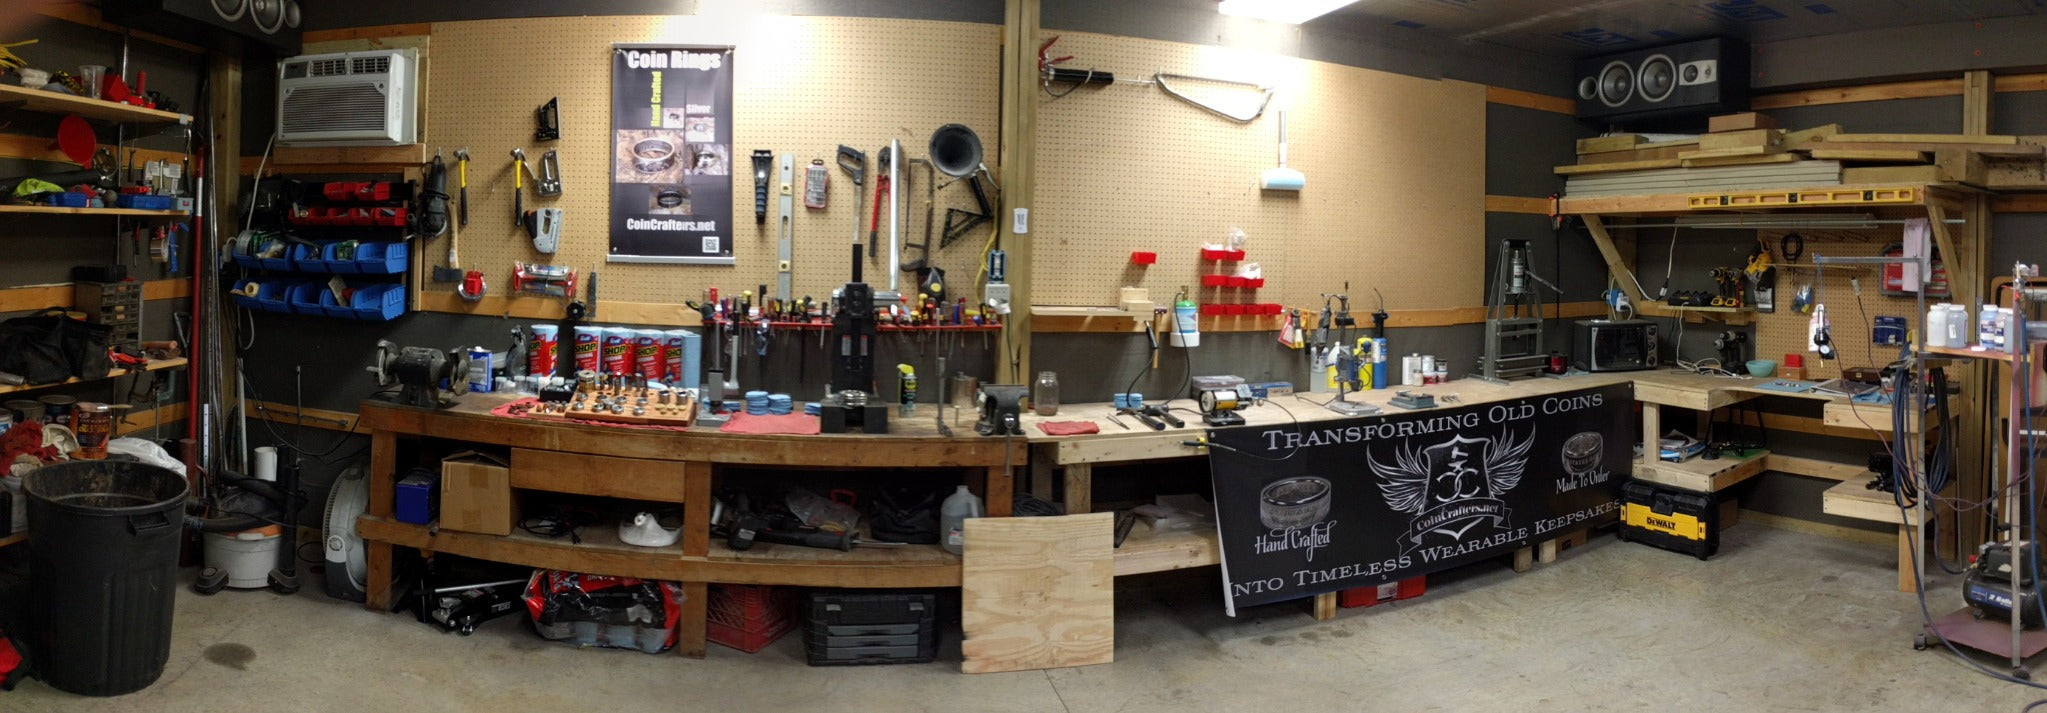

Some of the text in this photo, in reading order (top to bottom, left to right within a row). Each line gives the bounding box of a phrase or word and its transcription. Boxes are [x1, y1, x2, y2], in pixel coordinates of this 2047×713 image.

[627, 50, 721, 71] Coin Rings
[651, 71, 662, 103] Crafted
[686, 104, 711, 114] Silver
[576, 343, 596, 353] SHOP
[605, 346, 626, 355] SHOP
[1263, 393, 1604, 451] TRANSFORMING OLD COINS
[1556, 465, 1610, 495] Made To Order
[1416, 503, 1499, 531] CoinCrafters.net
[1255, 520, 1337, 562] Hand Crafted
[1292, 554, 1412, 587] TIMELESS
[1419, 527, 1528, 563] WEARABLE
[1534, 498, 1621, 535] KEEPSAKES
